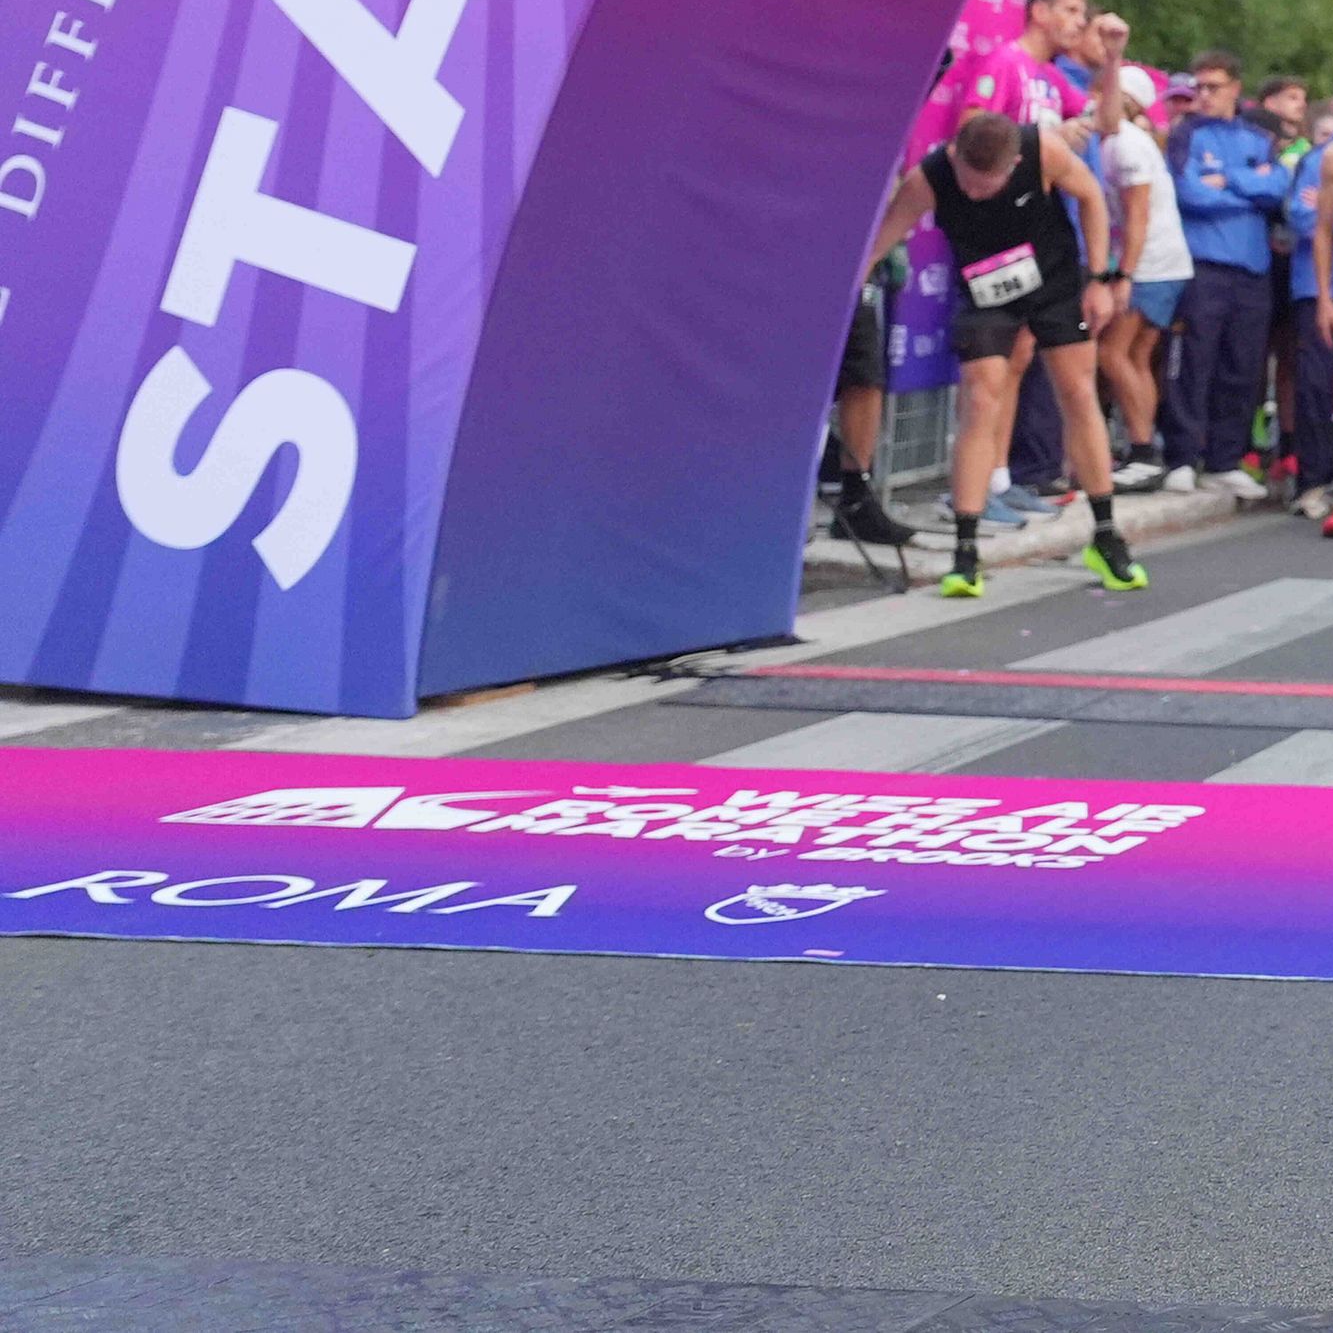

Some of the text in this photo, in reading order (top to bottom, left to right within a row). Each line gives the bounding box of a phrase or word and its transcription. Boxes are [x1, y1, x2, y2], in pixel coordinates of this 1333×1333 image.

[519, 798, 1190, 837] ROME HALF
[722, 789, 1206, 822] WIZZ AIR
[464, 814, 1148, 855] MARATHON
[711, 844, 1106, 870] by BROOKS
[5, 869, 578, 917] ROMA
